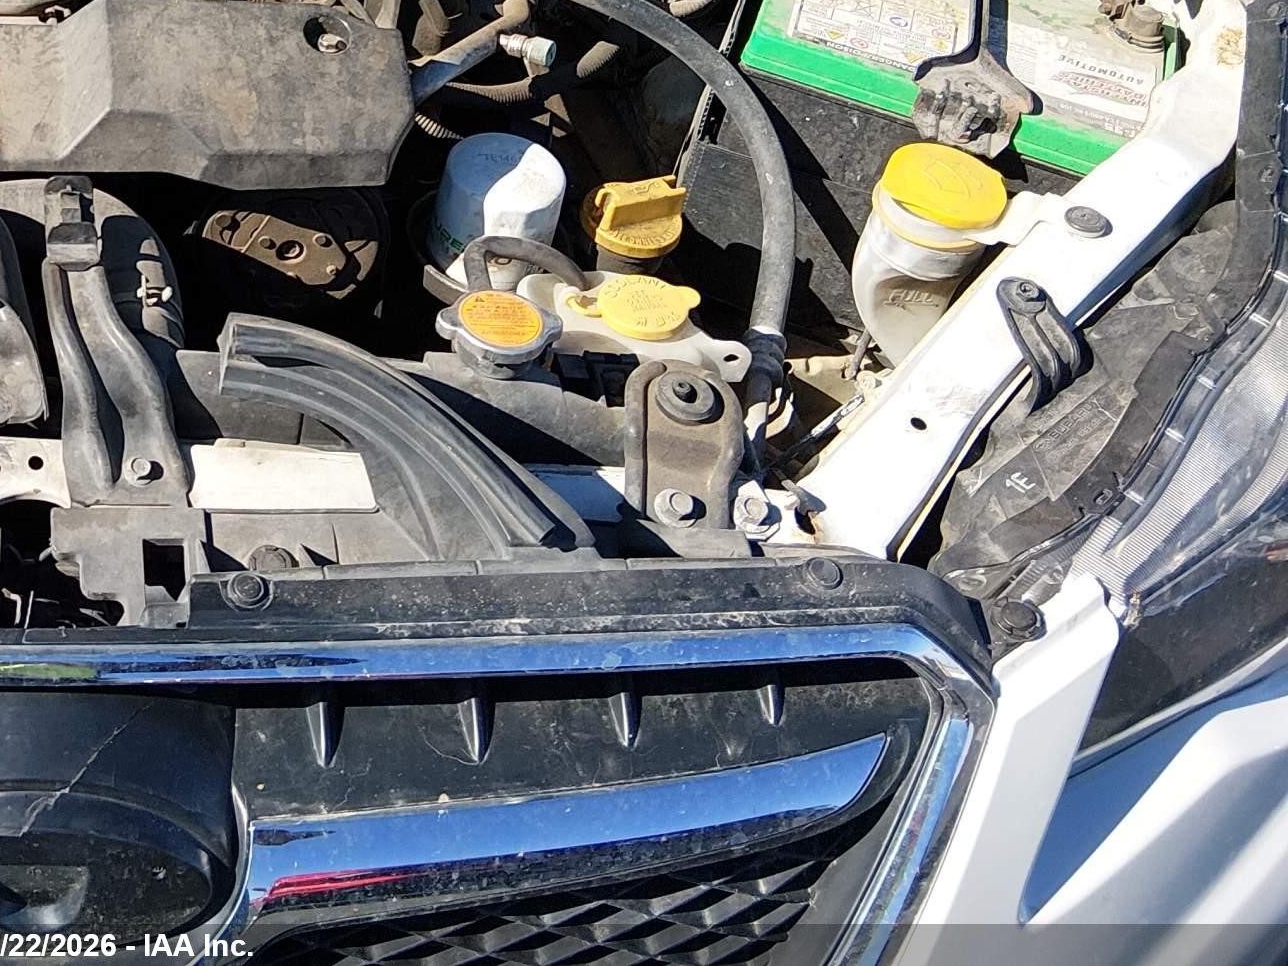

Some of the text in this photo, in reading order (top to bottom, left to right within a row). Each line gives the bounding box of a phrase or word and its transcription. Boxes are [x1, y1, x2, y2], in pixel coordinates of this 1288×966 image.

[1057, 54, 1144, 84] AUTOMOTIVE
[1047, 402, 1094, 440] SUBARU
[1005, 472, 1037, 494] 1E
